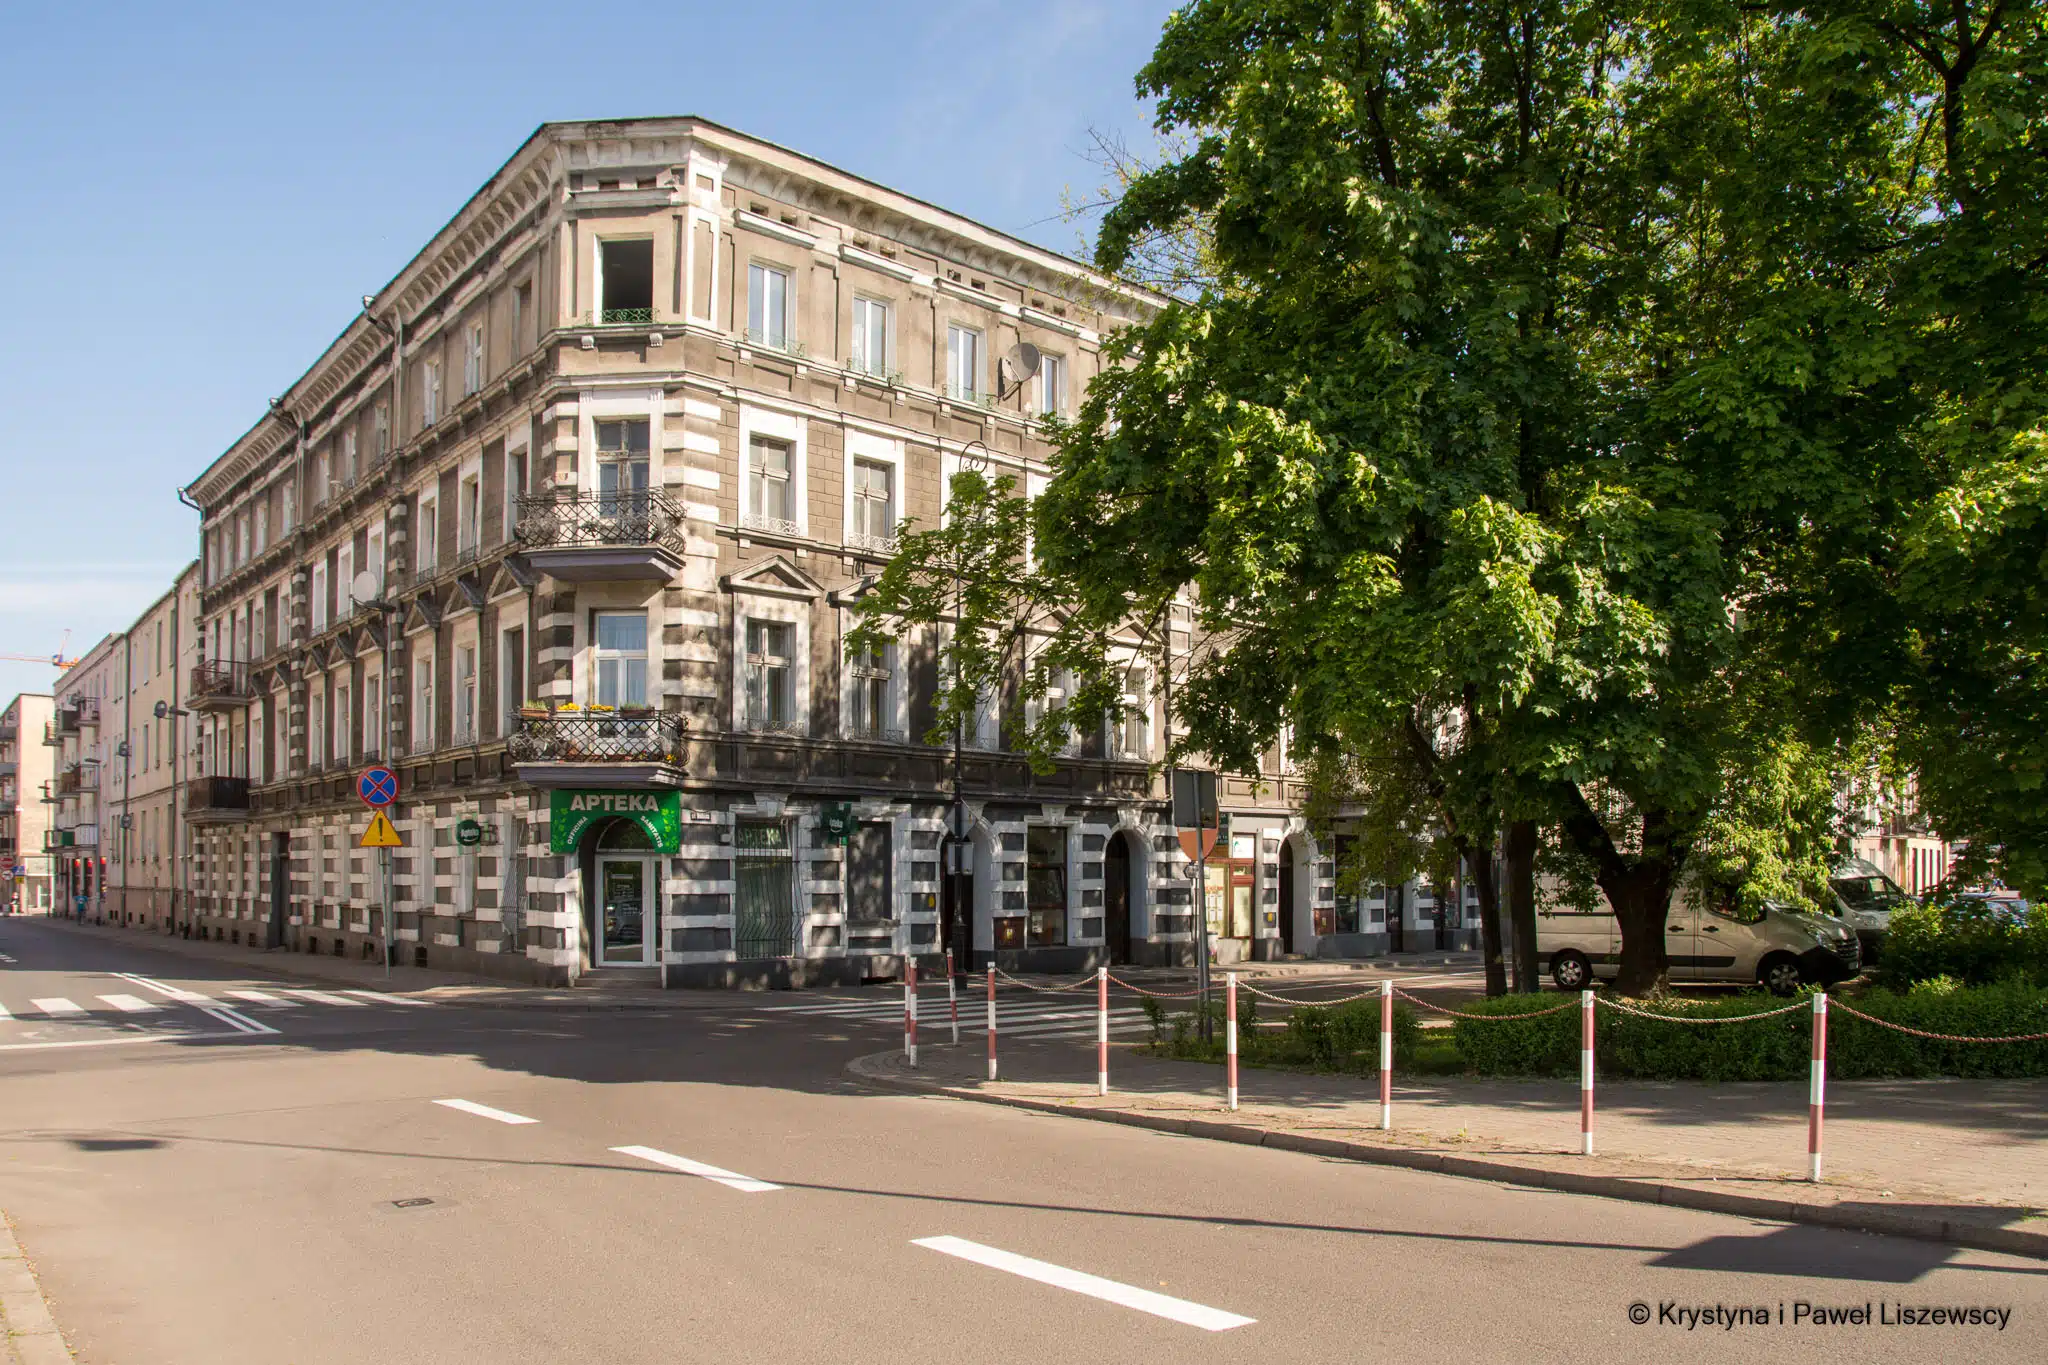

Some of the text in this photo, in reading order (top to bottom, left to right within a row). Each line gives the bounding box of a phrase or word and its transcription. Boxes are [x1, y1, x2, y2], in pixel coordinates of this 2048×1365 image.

[570, 794, 659, 811] APTEKA
[567, 816, 588, 845] OFFICINA
[640, 815, 664, 848] SANITATIS
[737, 828, 783, 846] APTEKA
